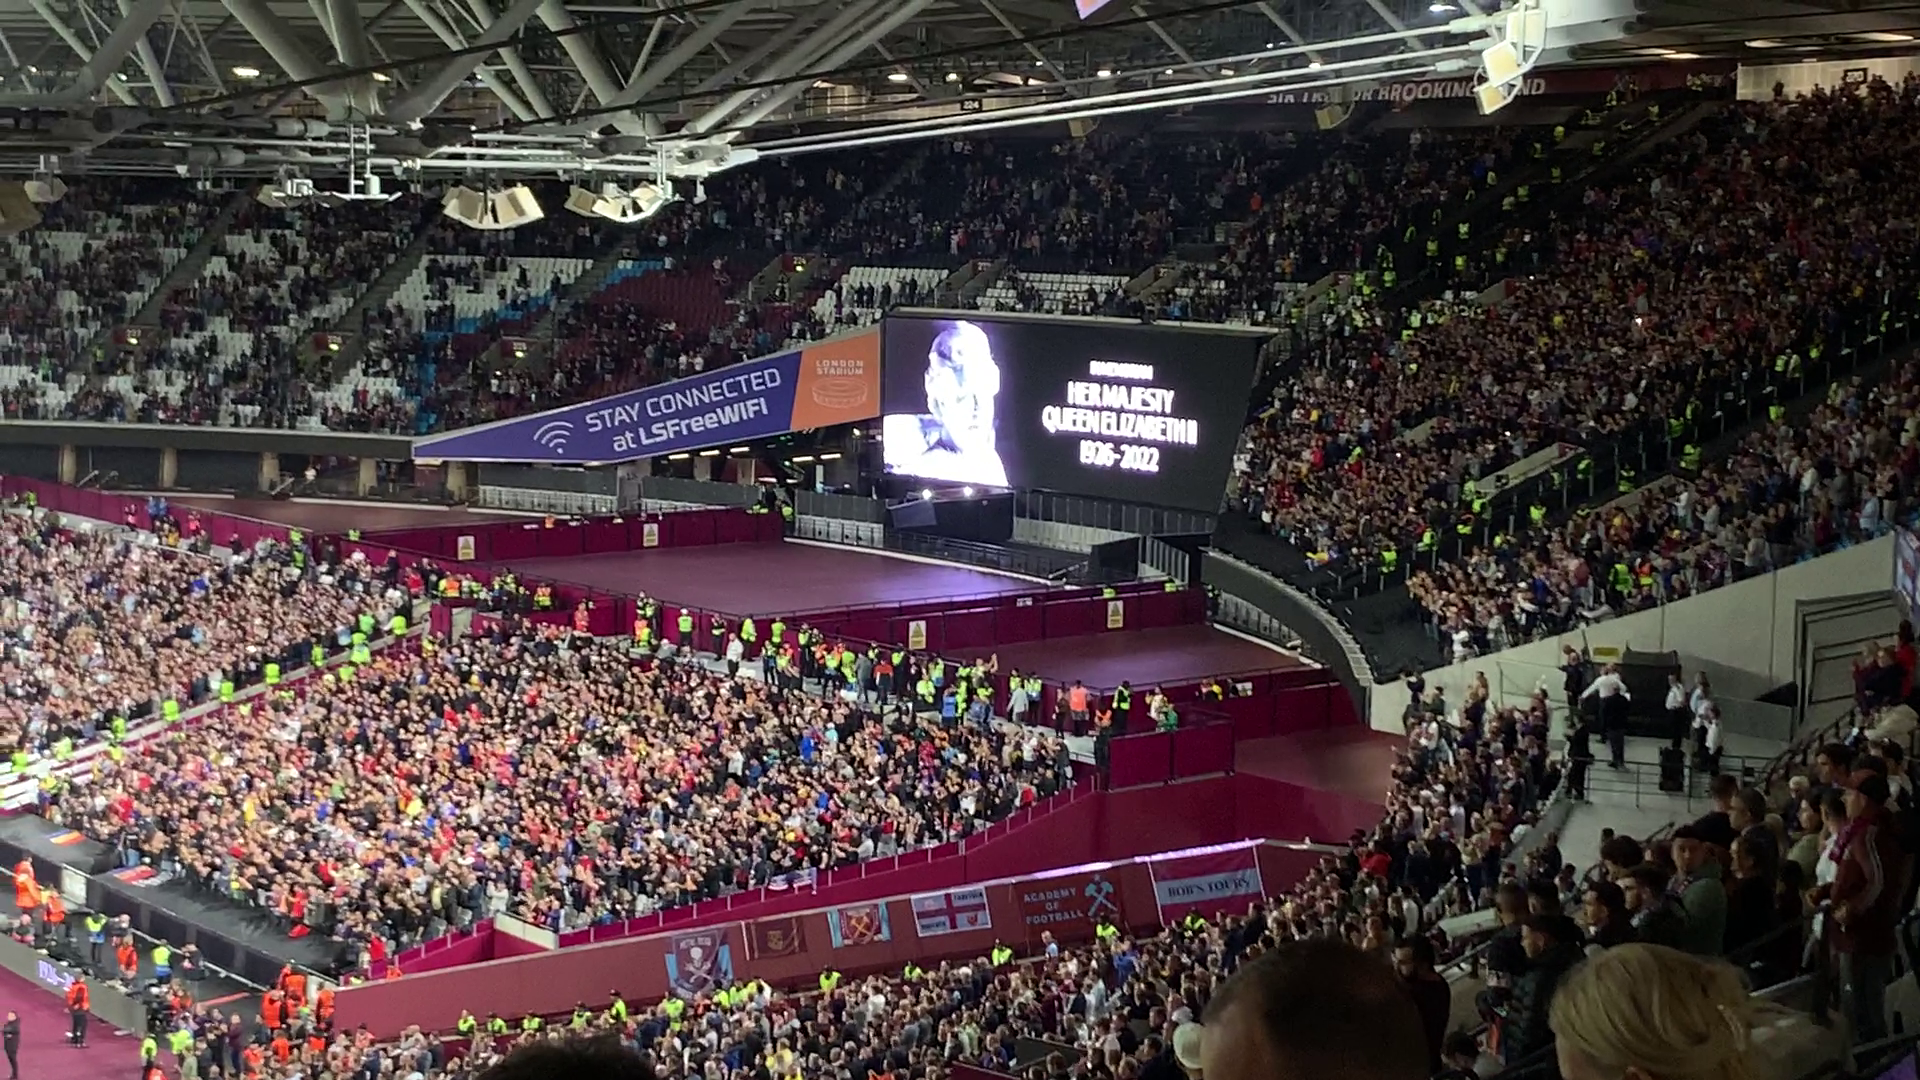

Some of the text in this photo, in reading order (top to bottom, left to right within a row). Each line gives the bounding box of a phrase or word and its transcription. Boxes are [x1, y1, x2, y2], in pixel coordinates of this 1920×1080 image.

[815, 359, 864, 367] LONDON
[816, 367, 864, 375] STADIUM
[585, 368, 781, 432] STAY CONNECTED
[1067, 380, 1175, 414] HER MAJESTY
[1042, 405, 1100, 434] QUEEN
[1101, 411, 1185, 443] ELIZABETH
[613, 430, 637, 452] at
[1024, 887, 1076, 903] ACADEMY
[1045, 901, 1059, 912] OF
[1026, 909, 1084, 925] FOOTBALL
